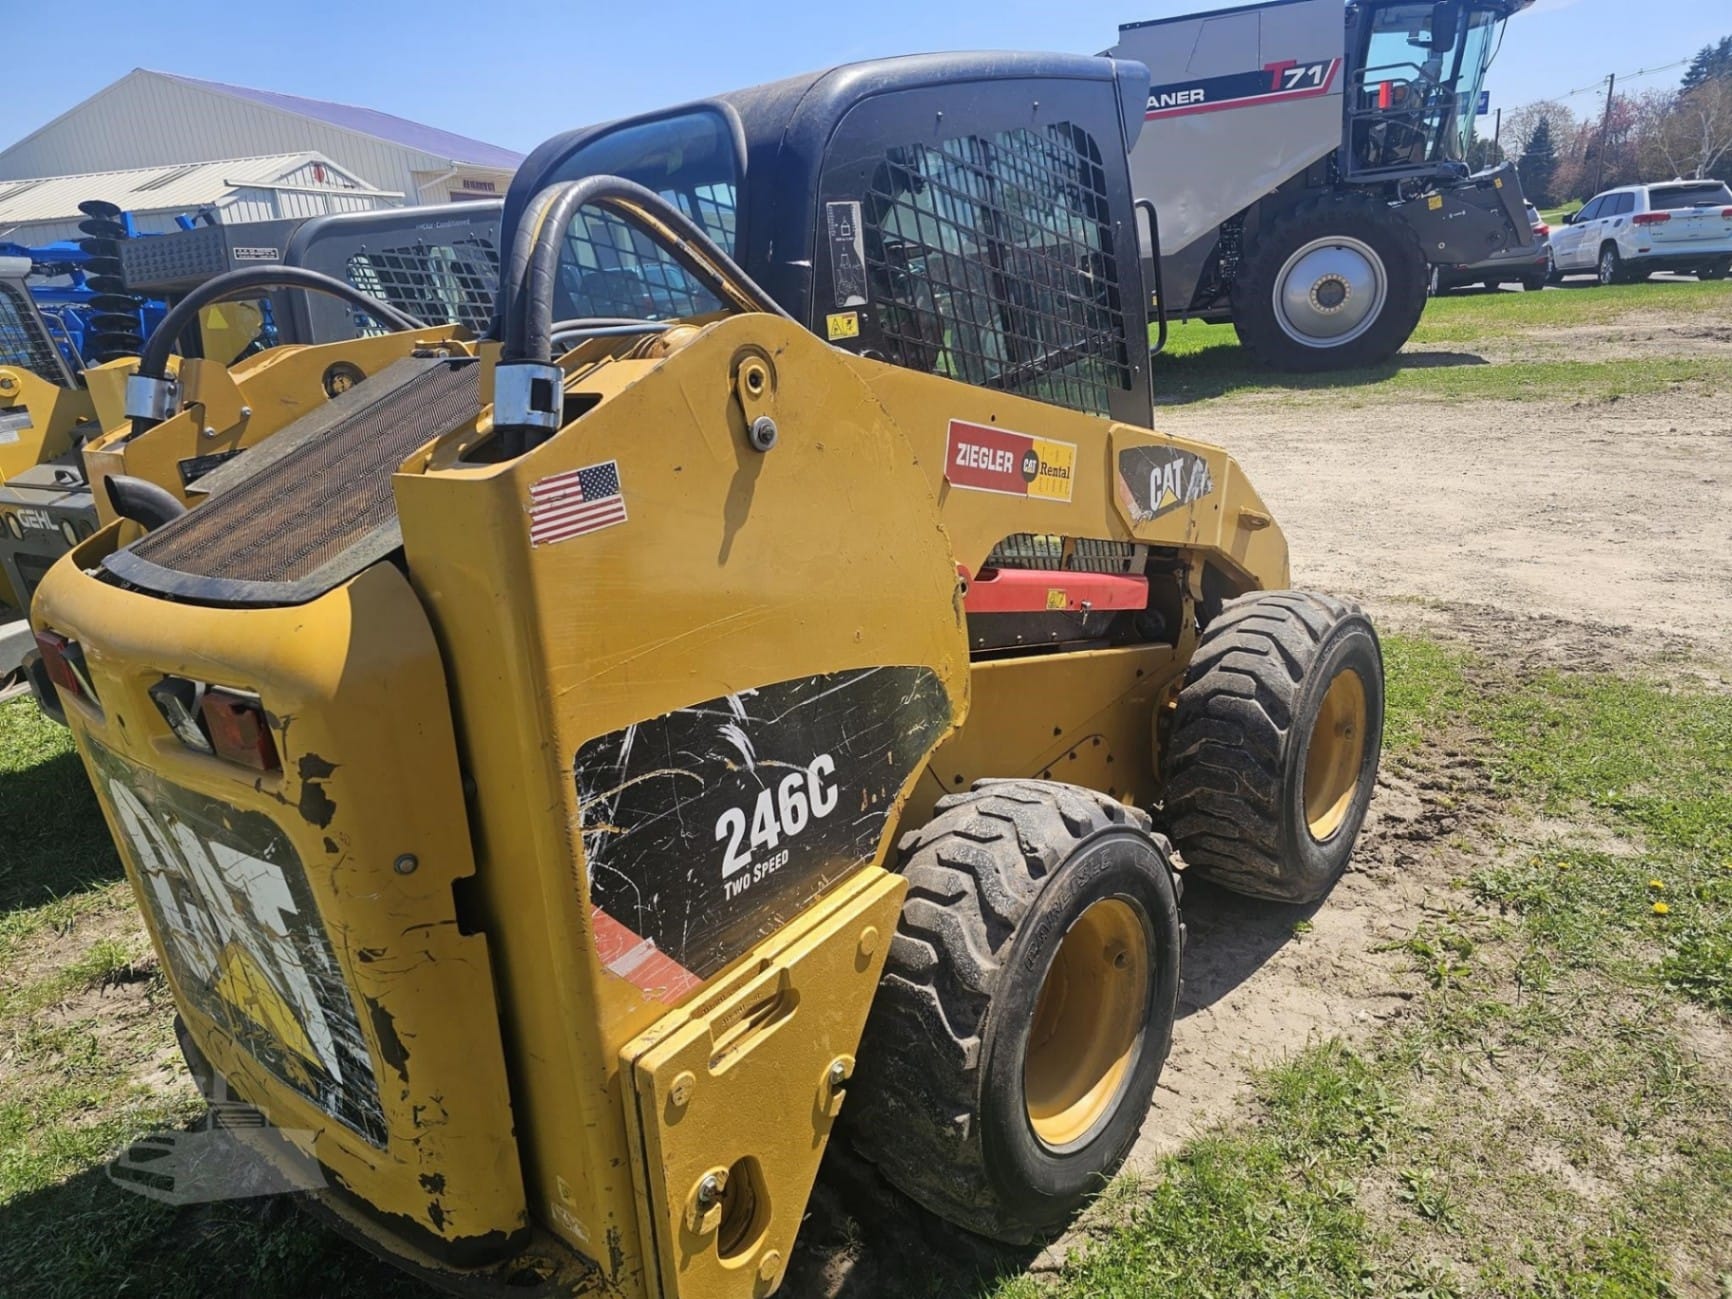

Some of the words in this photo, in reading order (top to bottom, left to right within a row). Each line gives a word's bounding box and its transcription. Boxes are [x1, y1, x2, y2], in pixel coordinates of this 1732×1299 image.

[1264, 60, 1322, 90] T71
[1146, 89, 1204, 108] ANER
[955, 443, 1014, 473] ZIEGLER
[1023, 458, 1037, 473] CAT
[1039, 462, 1070, 479] Rental
[1150, 458, 1184, 511] CAT
[17, 509, 59, 530] GEHL
[715, 753, 839, 879] 246C
